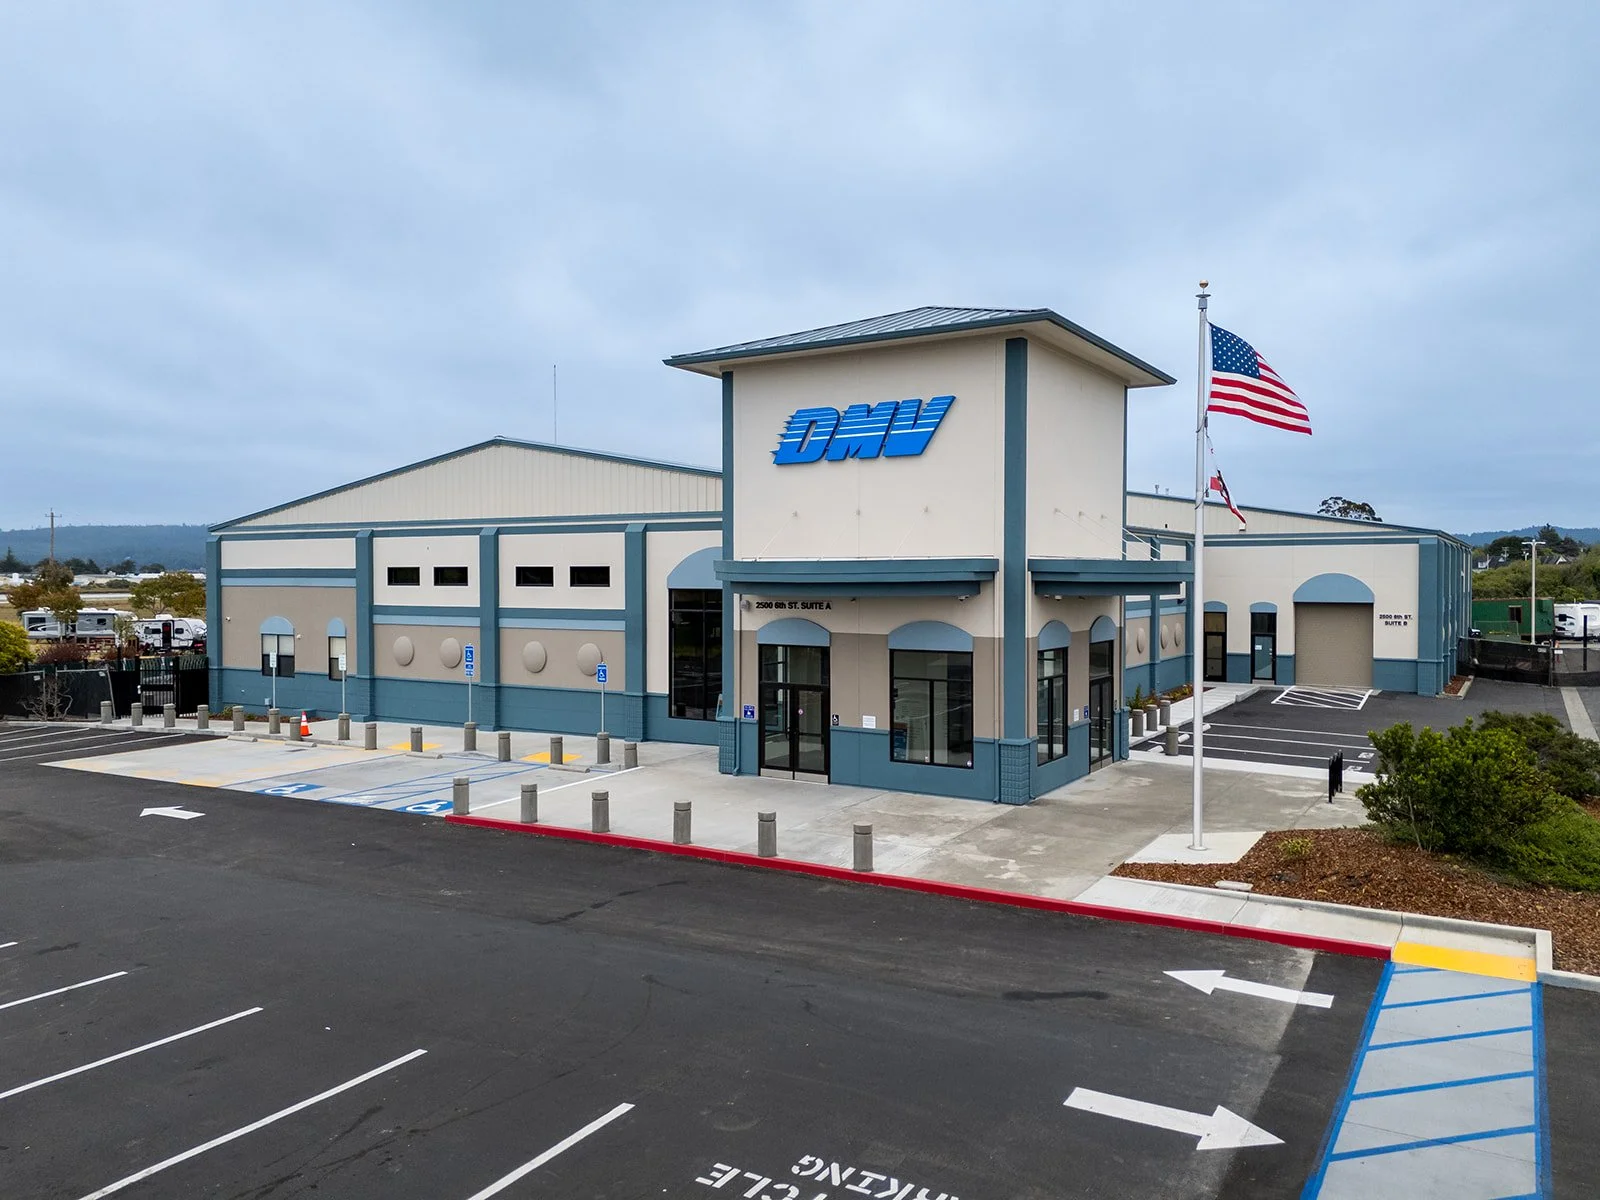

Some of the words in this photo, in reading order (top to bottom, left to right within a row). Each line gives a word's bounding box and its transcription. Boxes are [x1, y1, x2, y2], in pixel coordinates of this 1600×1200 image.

[770, 395, 957, 465] DMV
[755, 601, 773, 609] 2500
[774, 601, 787, 609] 6th
[787, 602, 799, 610] ST.
[800, 602, 824, 610] SUITE
[825, 602, 832, 610] A
[791, 1154, 959, 1200] KING
